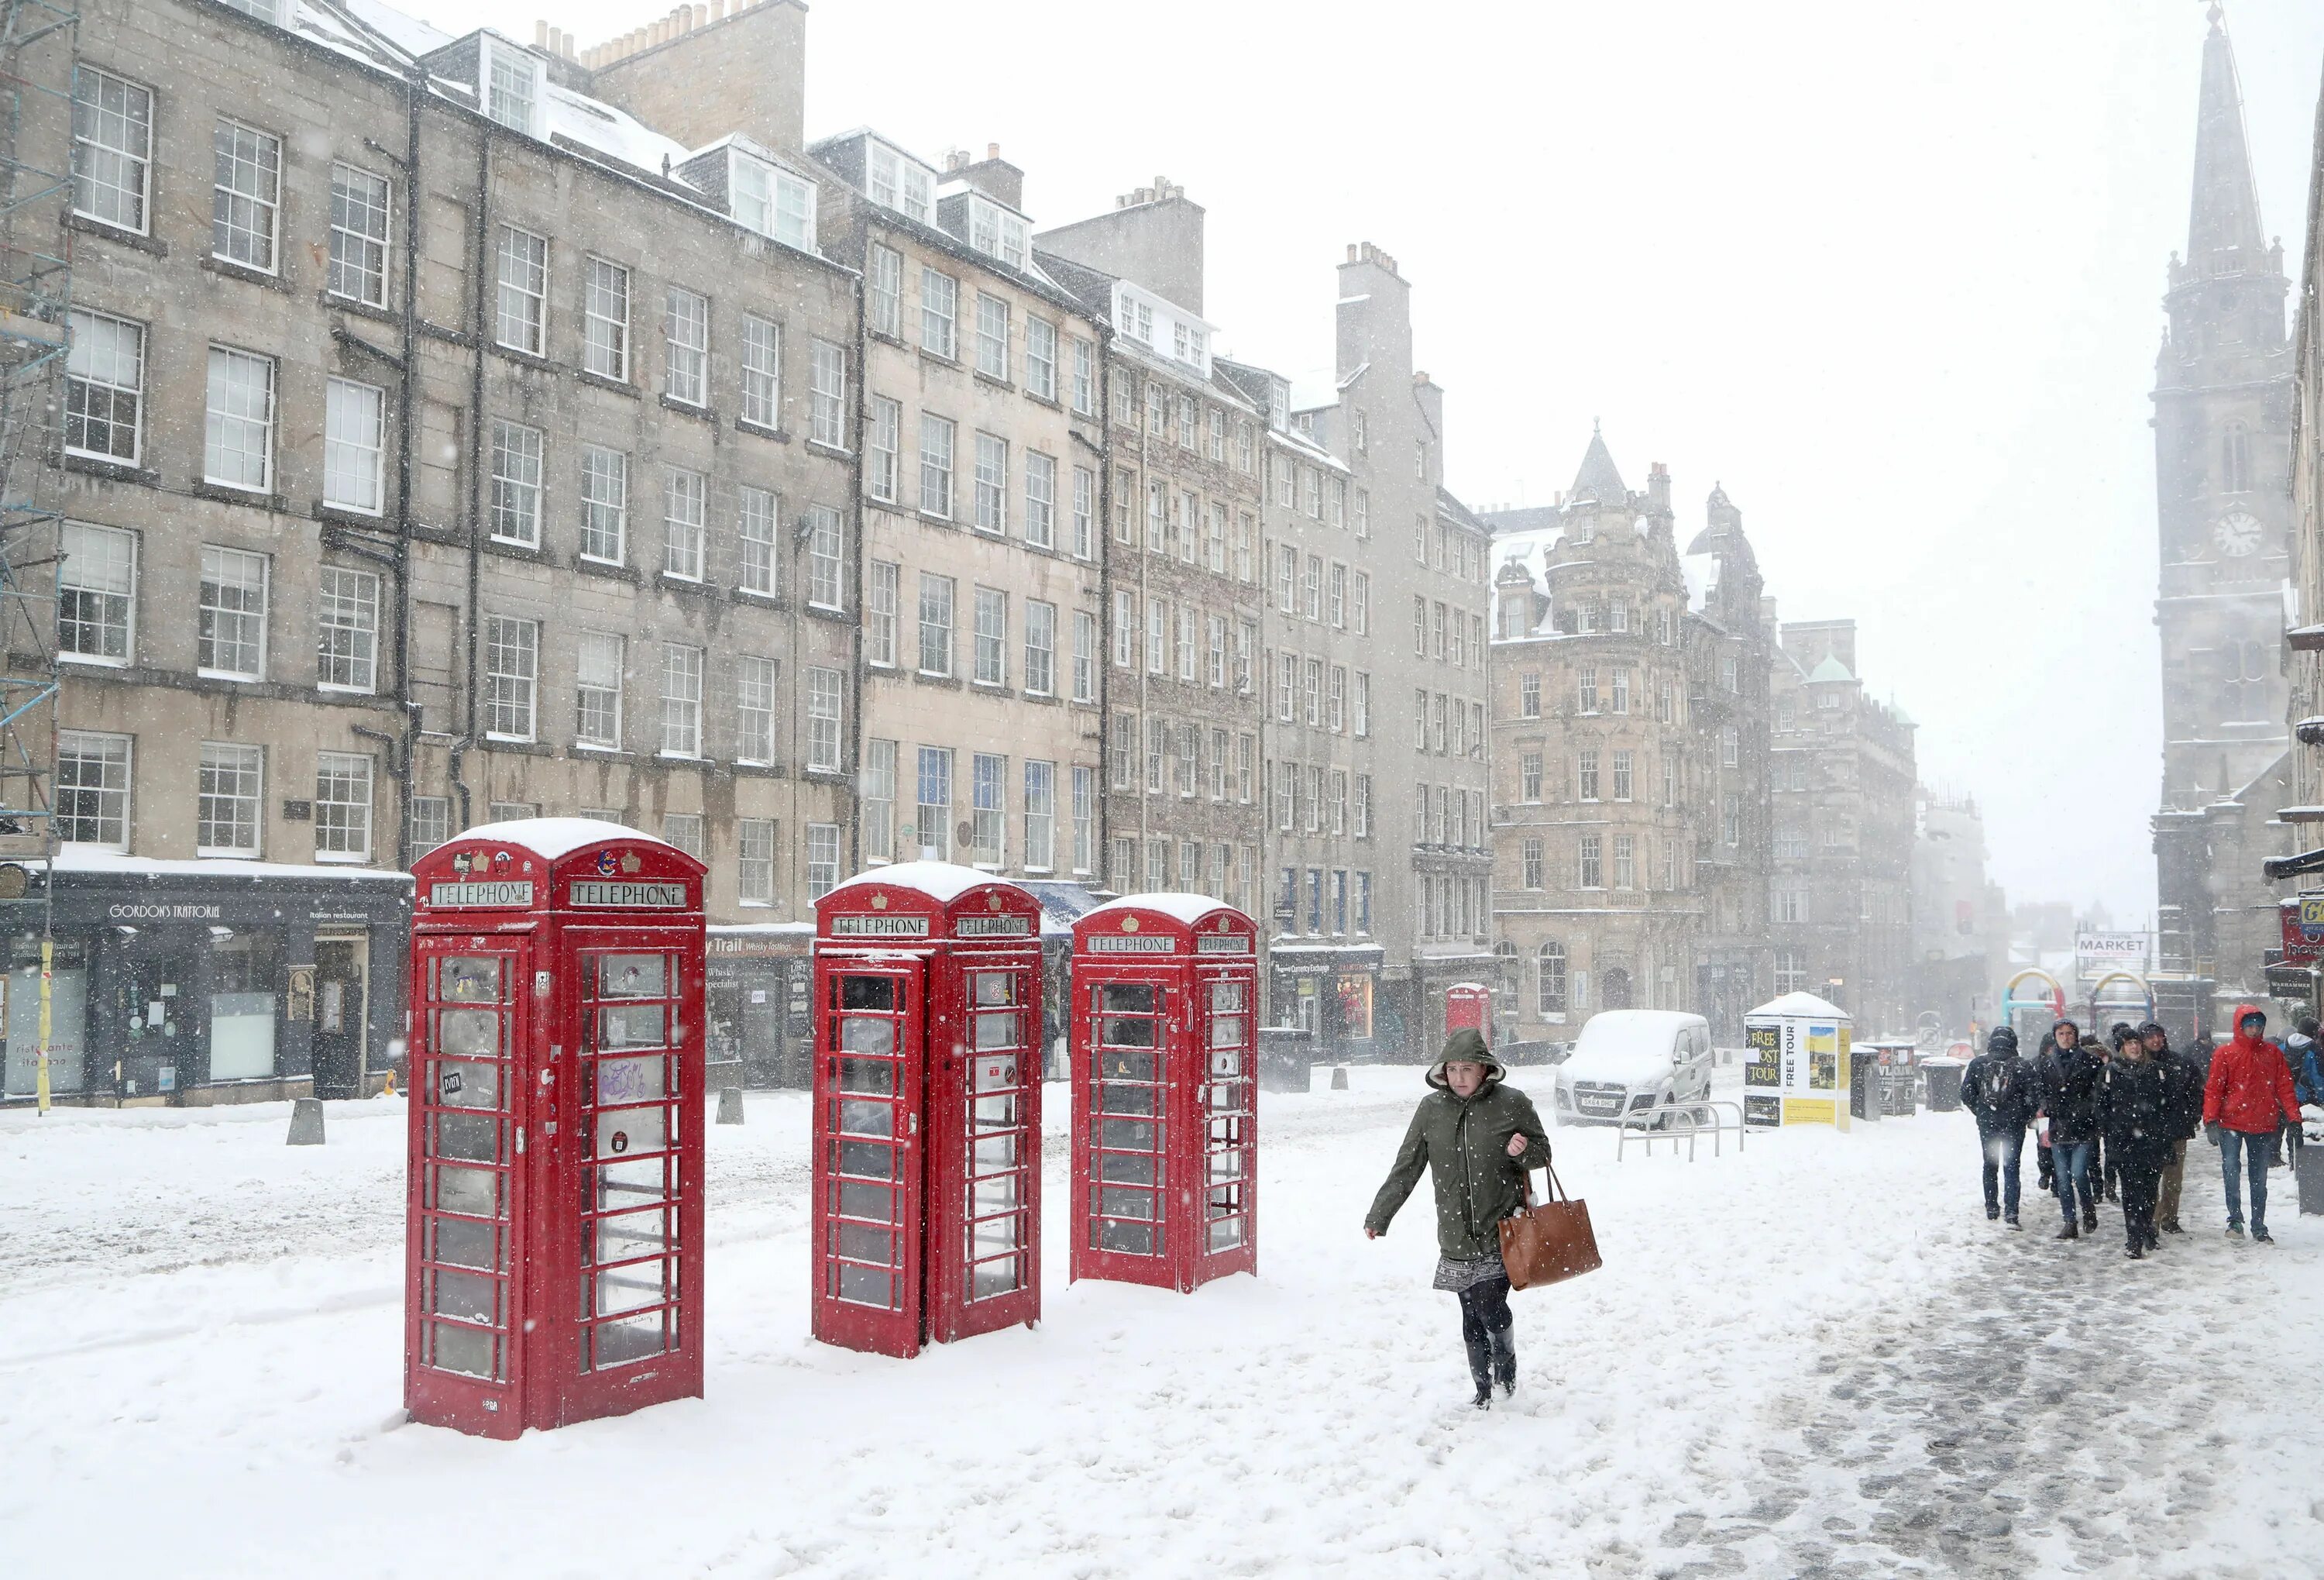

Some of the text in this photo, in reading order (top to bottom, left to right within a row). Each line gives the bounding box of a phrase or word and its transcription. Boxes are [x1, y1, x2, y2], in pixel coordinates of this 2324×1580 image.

[435, 883, 531, 904] TELEPHONE
[573, 884, 680, 905] TELEPHONE
[109, 904, 220, 918] GORDON'S TRATTORIA
[838, 918, 927, 934] TELEPHONE
[958, 918, 1025, 935] TELEPHONE
[714, 938, 742, 952] Trail
[745, 942, 767, 952] Whisky
[1091, 938, 1171, 952] TELEPHONE
[1200, 938, 1246, 951] TELEPHONE
[2080, 940, 2144, 951] MARKET
[708, 966, 735, 977] Whisky
[1752, 1031, 1775, 1046] FREE
[1786, 1026, 1795, 1055] TOUR
[1750, 1066, 1777, 1081] TOUR
[1786, 1059, 1795, 1086] FREE
